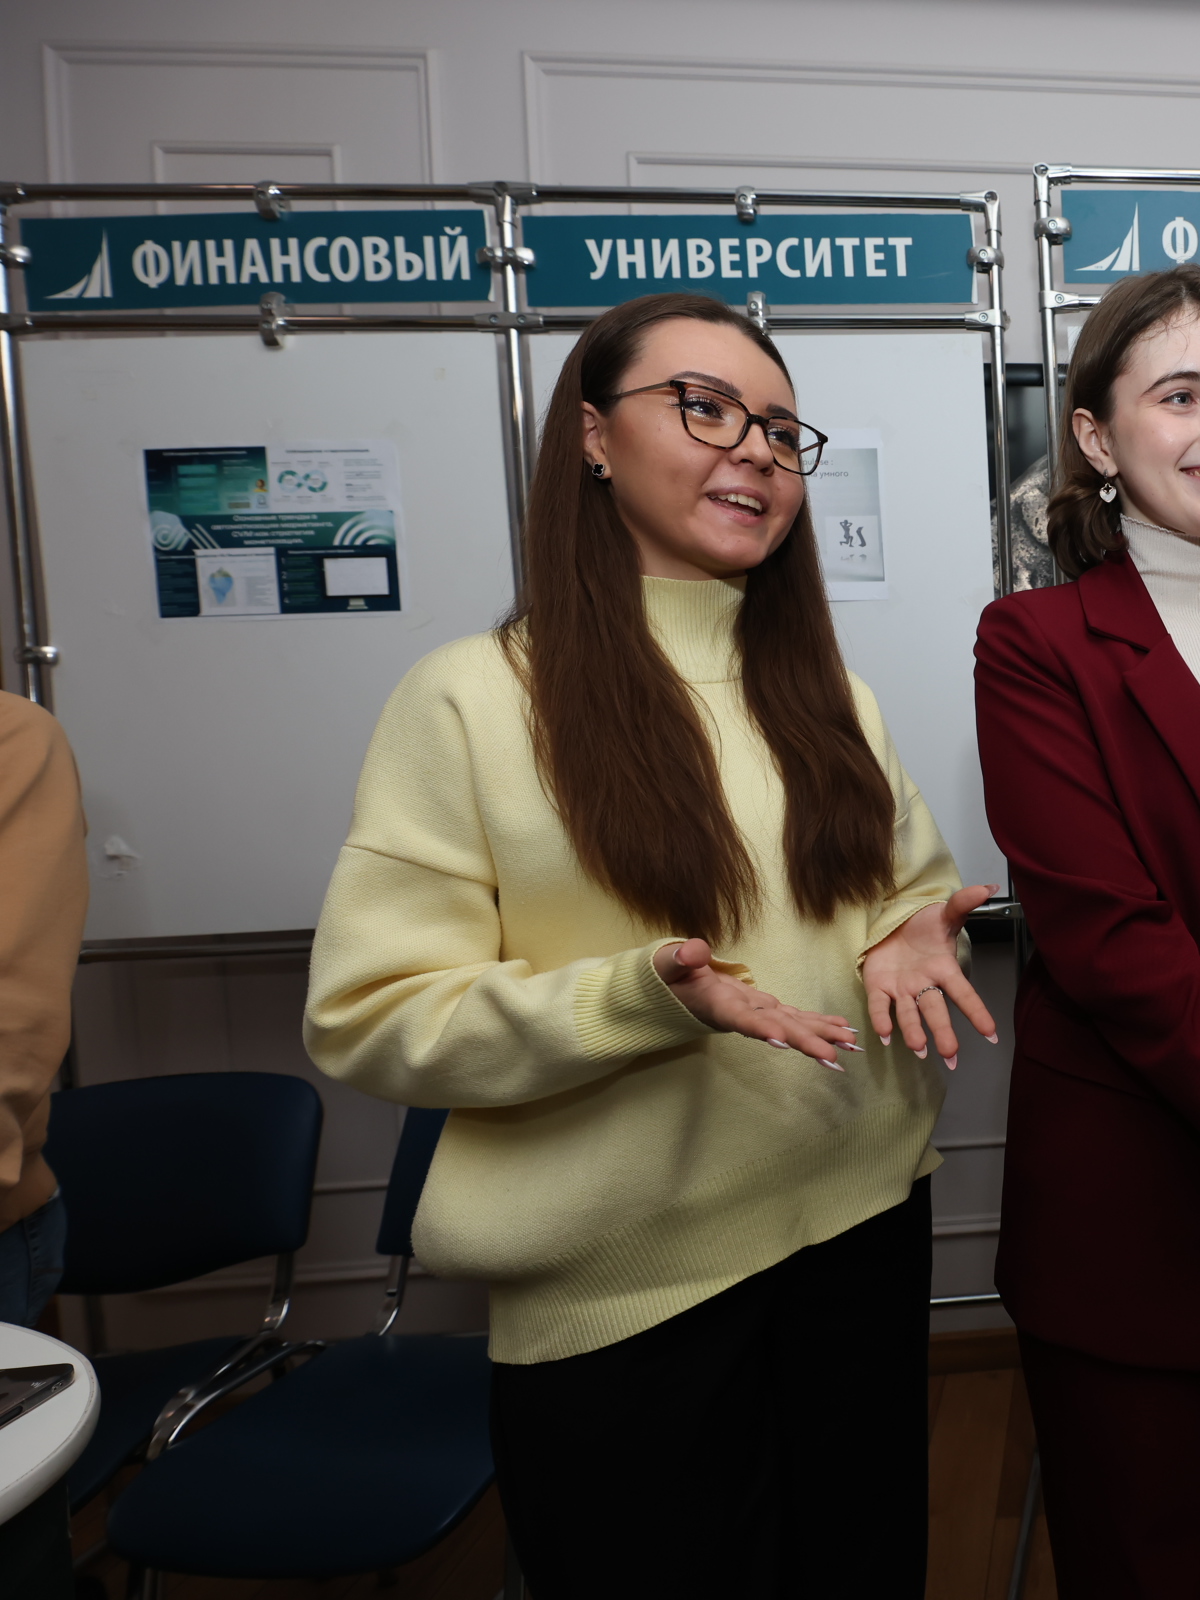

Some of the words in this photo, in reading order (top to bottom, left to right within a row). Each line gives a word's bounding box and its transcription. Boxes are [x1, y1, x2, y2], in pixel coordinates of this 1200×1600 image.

[132, 226, 471, 288] ФИНАНСОВЫЙ
[584, 237, 913, 280] УНИВЕРСИТЕТ
[819, 471, 849, 479] умного
